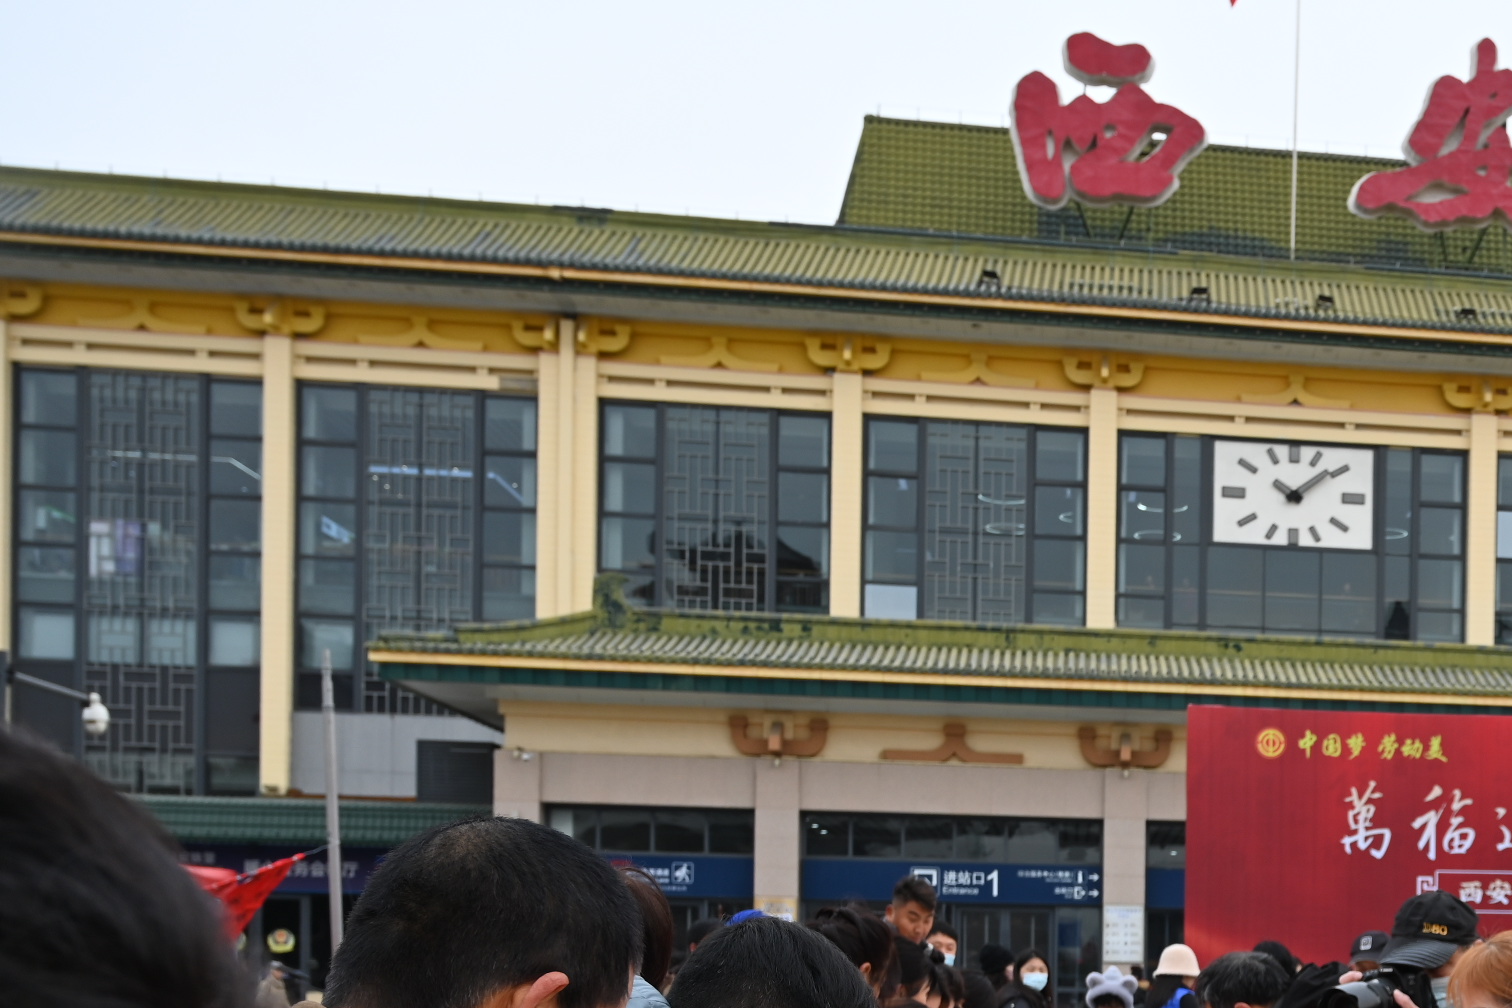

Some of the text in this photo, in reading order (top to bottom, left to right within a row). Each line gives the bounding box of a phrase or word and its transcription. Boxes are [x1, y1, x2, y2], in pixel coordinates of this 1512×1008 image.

[1298, 729, 1449, 763] 中国梦 劳动美
[943, 870, 985, 886] 进站口
[986, 869, 999, 897] 1
